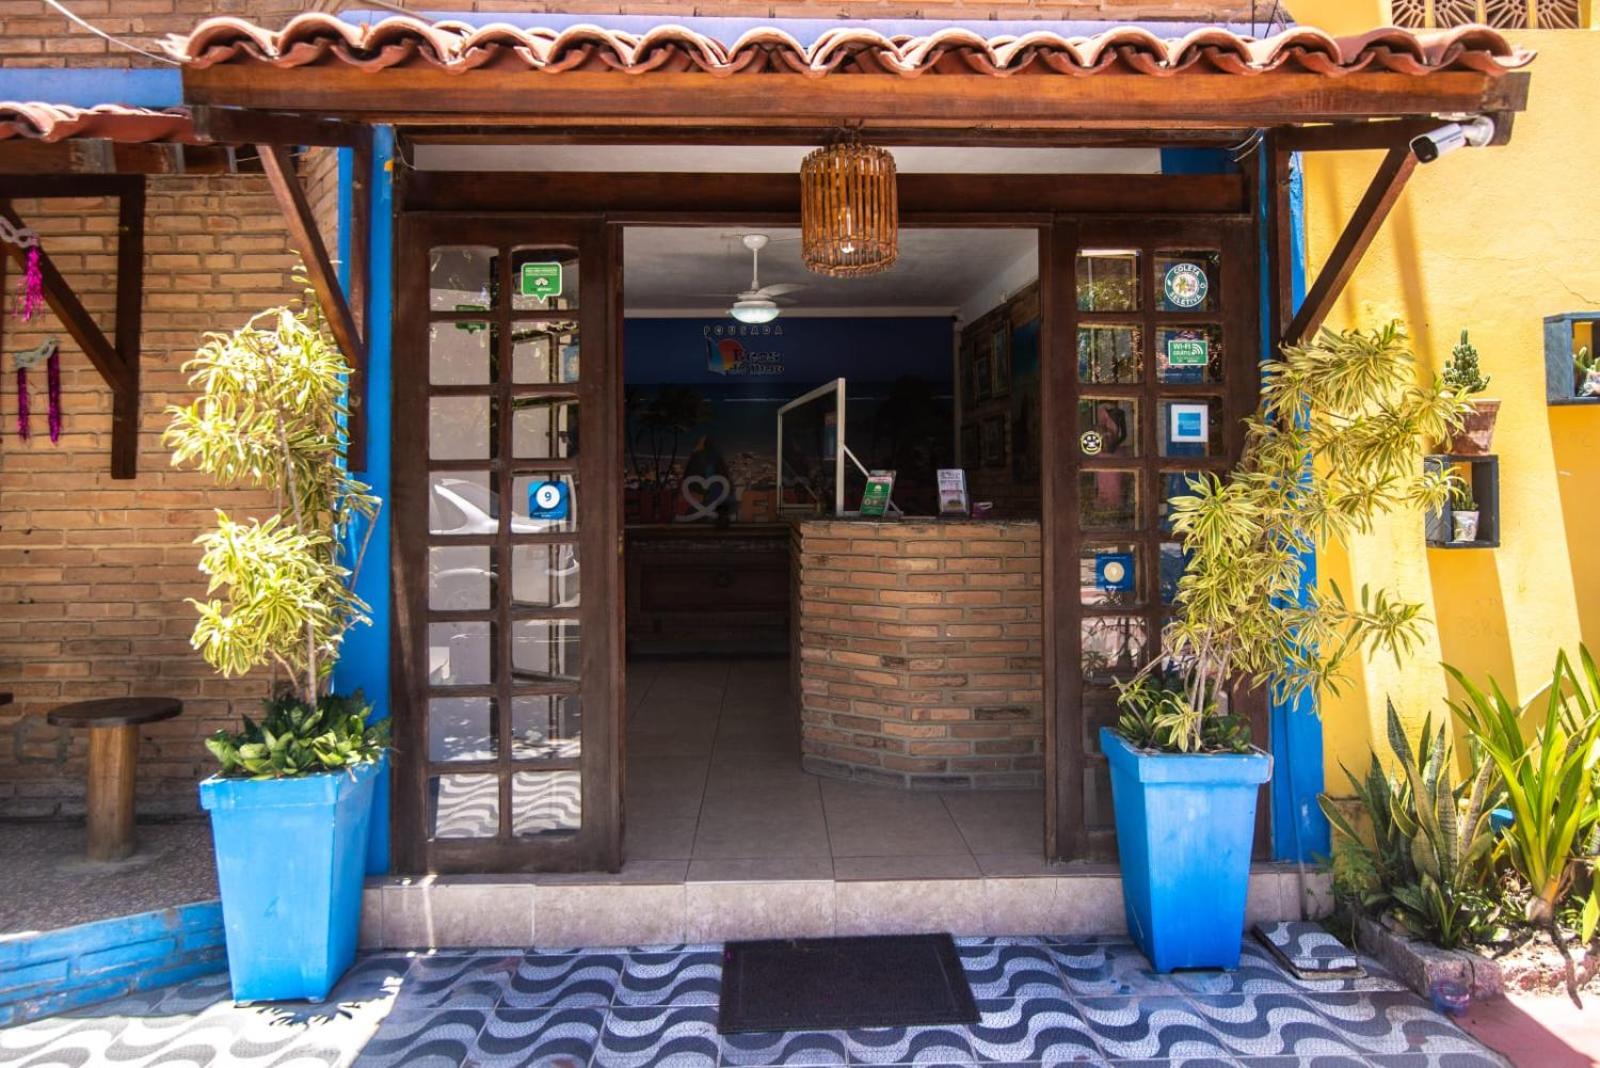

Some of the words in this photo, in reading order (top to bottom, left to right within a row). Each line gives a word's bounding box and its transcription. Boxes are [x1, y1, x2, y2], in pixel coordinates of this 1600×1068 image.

[1173, 265, 1200, 276] COLETA
[1170, 291, 1201, 305] SELETIVA
[544, 491, 552, 501] 9
